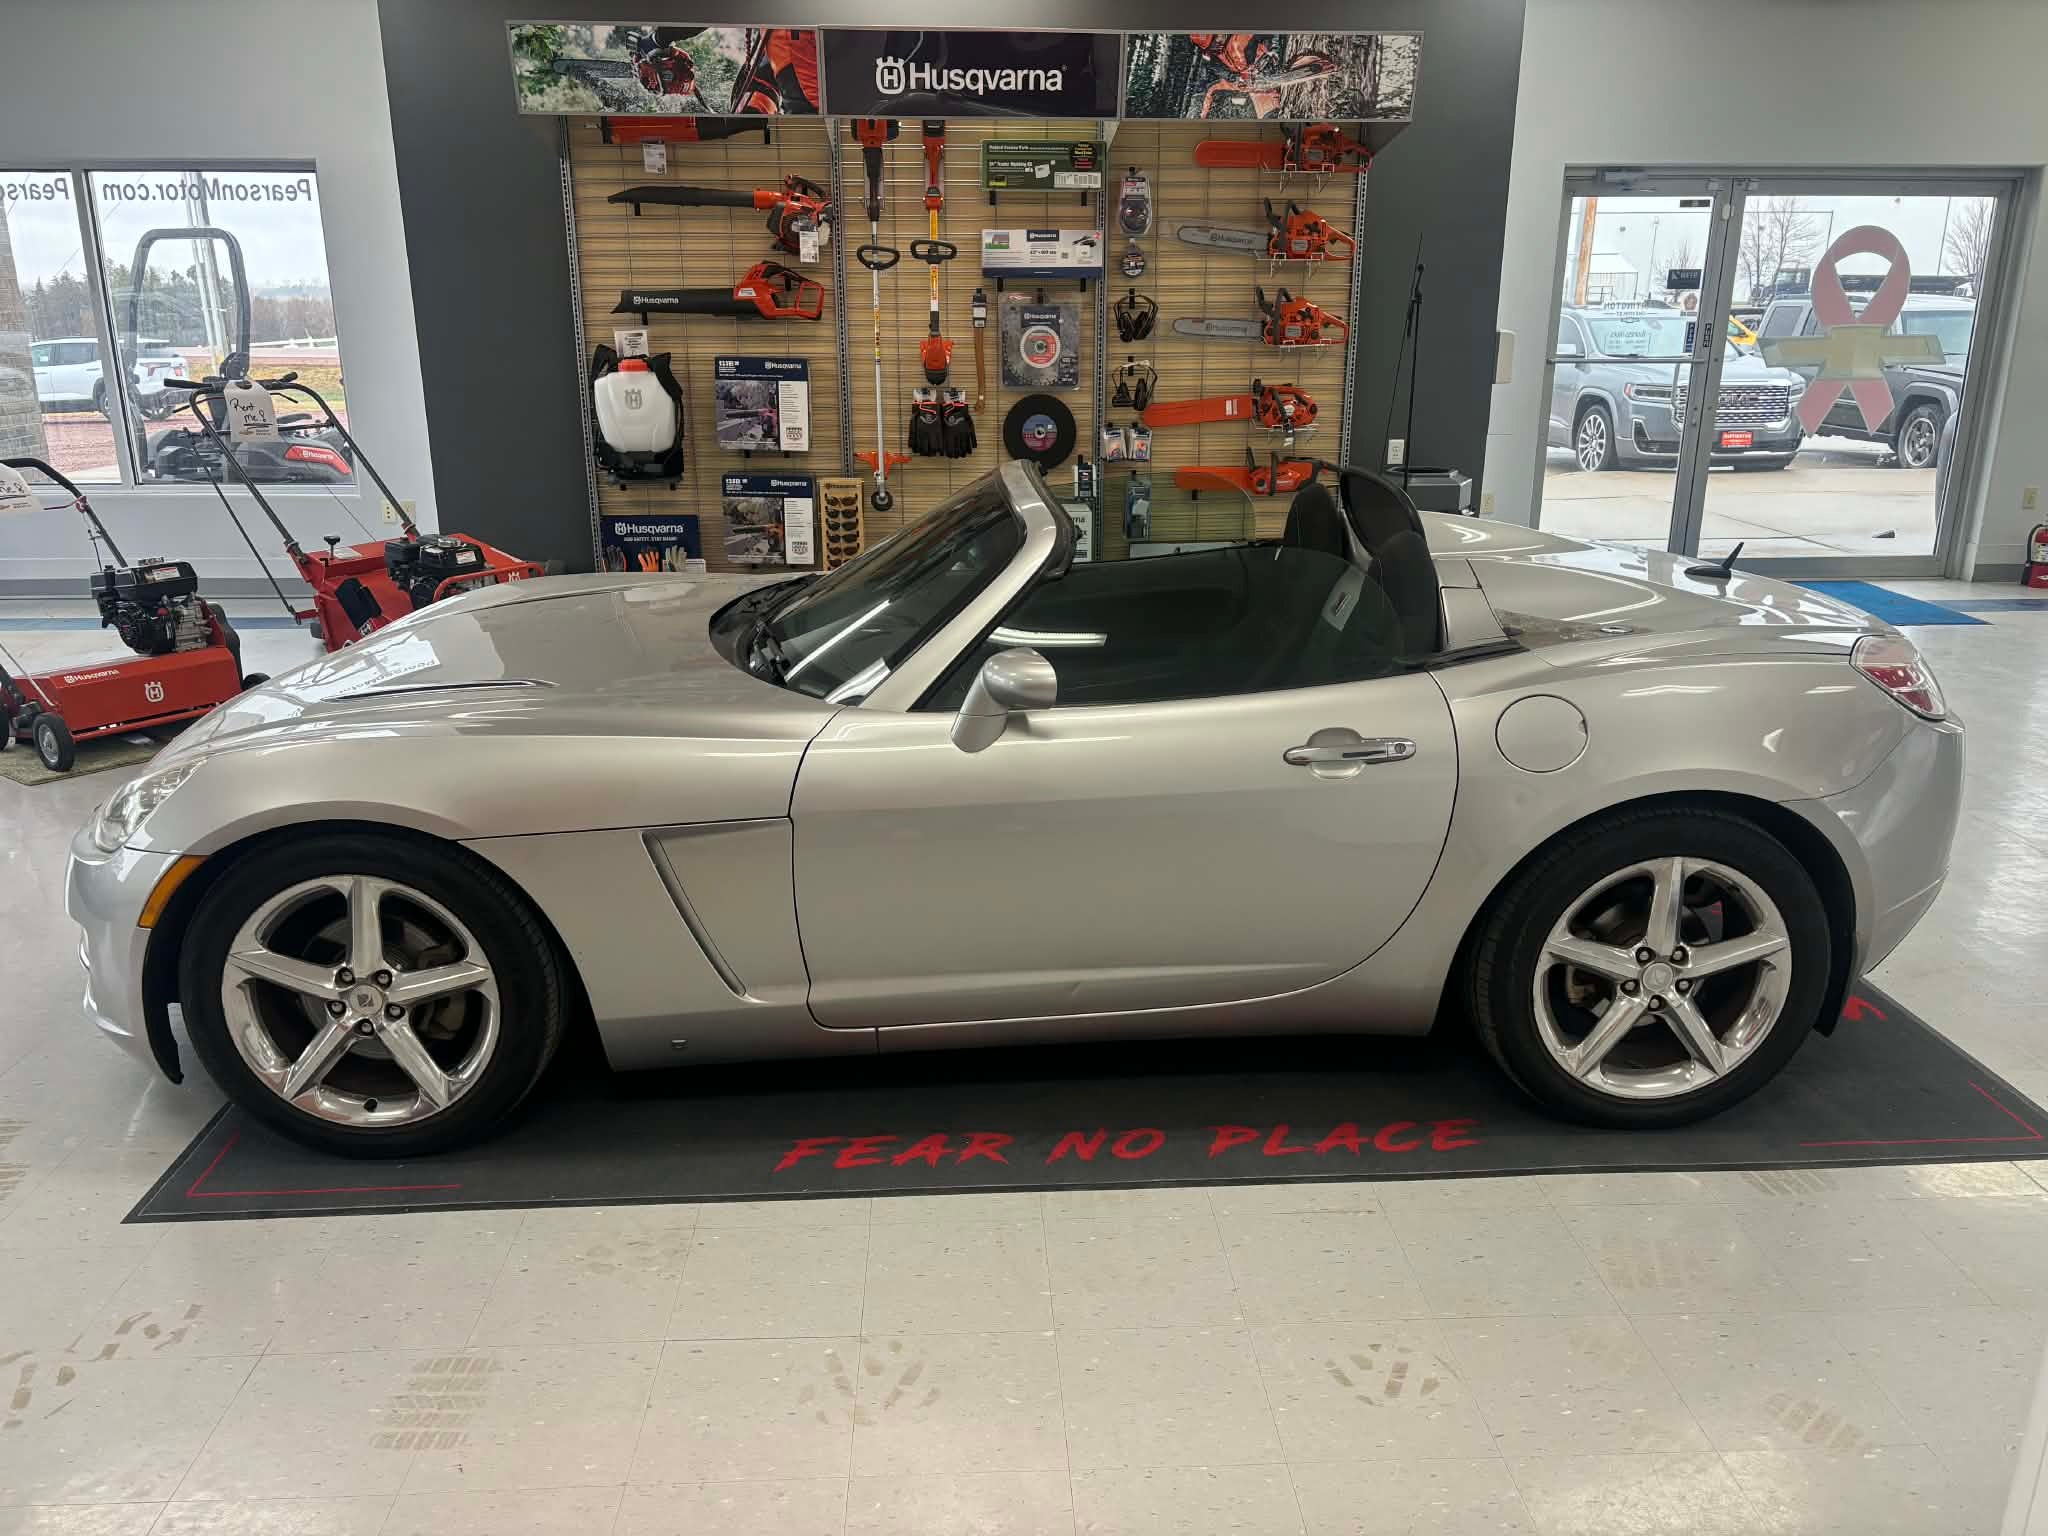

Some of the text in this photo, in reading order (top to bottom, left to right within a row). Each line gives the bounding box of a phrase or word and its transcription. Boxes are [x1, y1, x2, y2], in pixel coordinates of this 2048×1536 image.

[909, 61, 1063, 95] Husqvarna
[641, 296, 679, 304] Husqvarna
[230, 397, 256, 412] Rent
[627, 523, 684, 535] Husqvarna
[75, 669, 120, 682] Husqvarna
[773, 1119, 1482, 1172] FEAR NO PLACE
